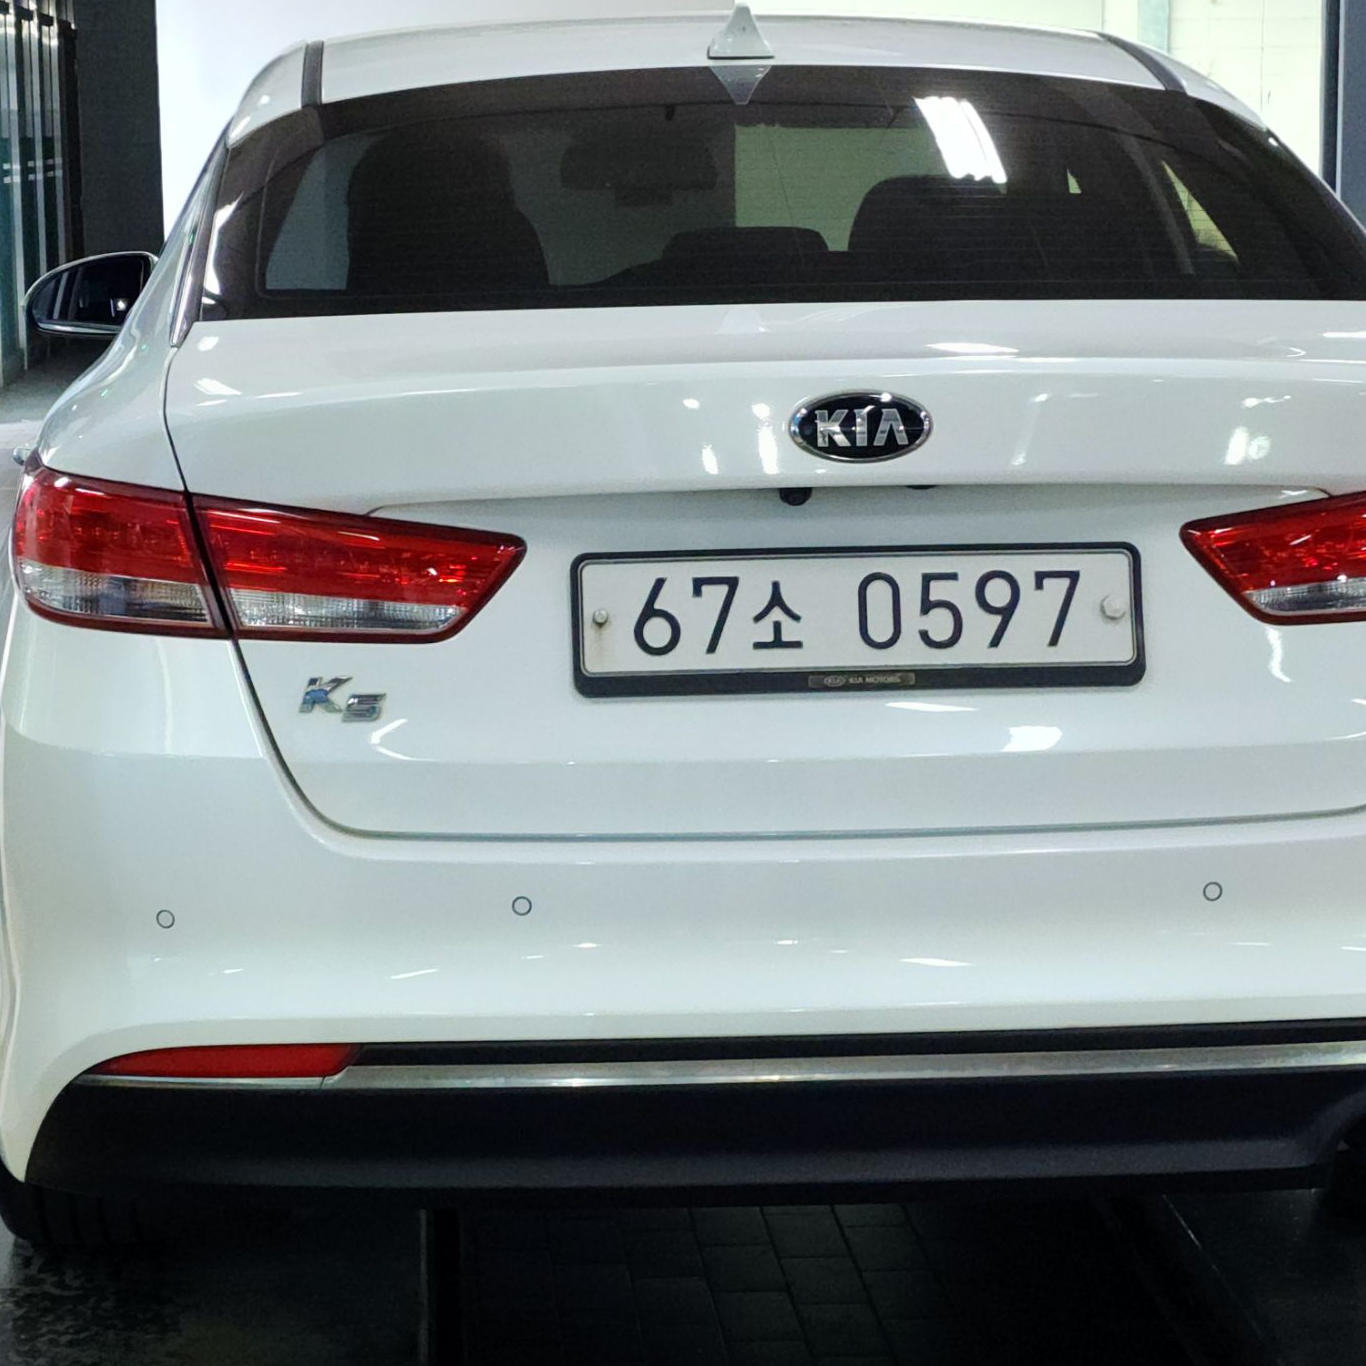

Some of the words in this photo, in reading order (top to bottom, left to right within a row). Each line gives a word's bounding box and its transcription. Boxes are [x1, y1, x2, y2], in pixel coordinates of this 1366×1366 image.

[814, 407, 909, 447] KIA
[634, 576, 804, 656] 67소
[857, 570, 1081, 650] 0597
[299, 676, 387, 723] K5
